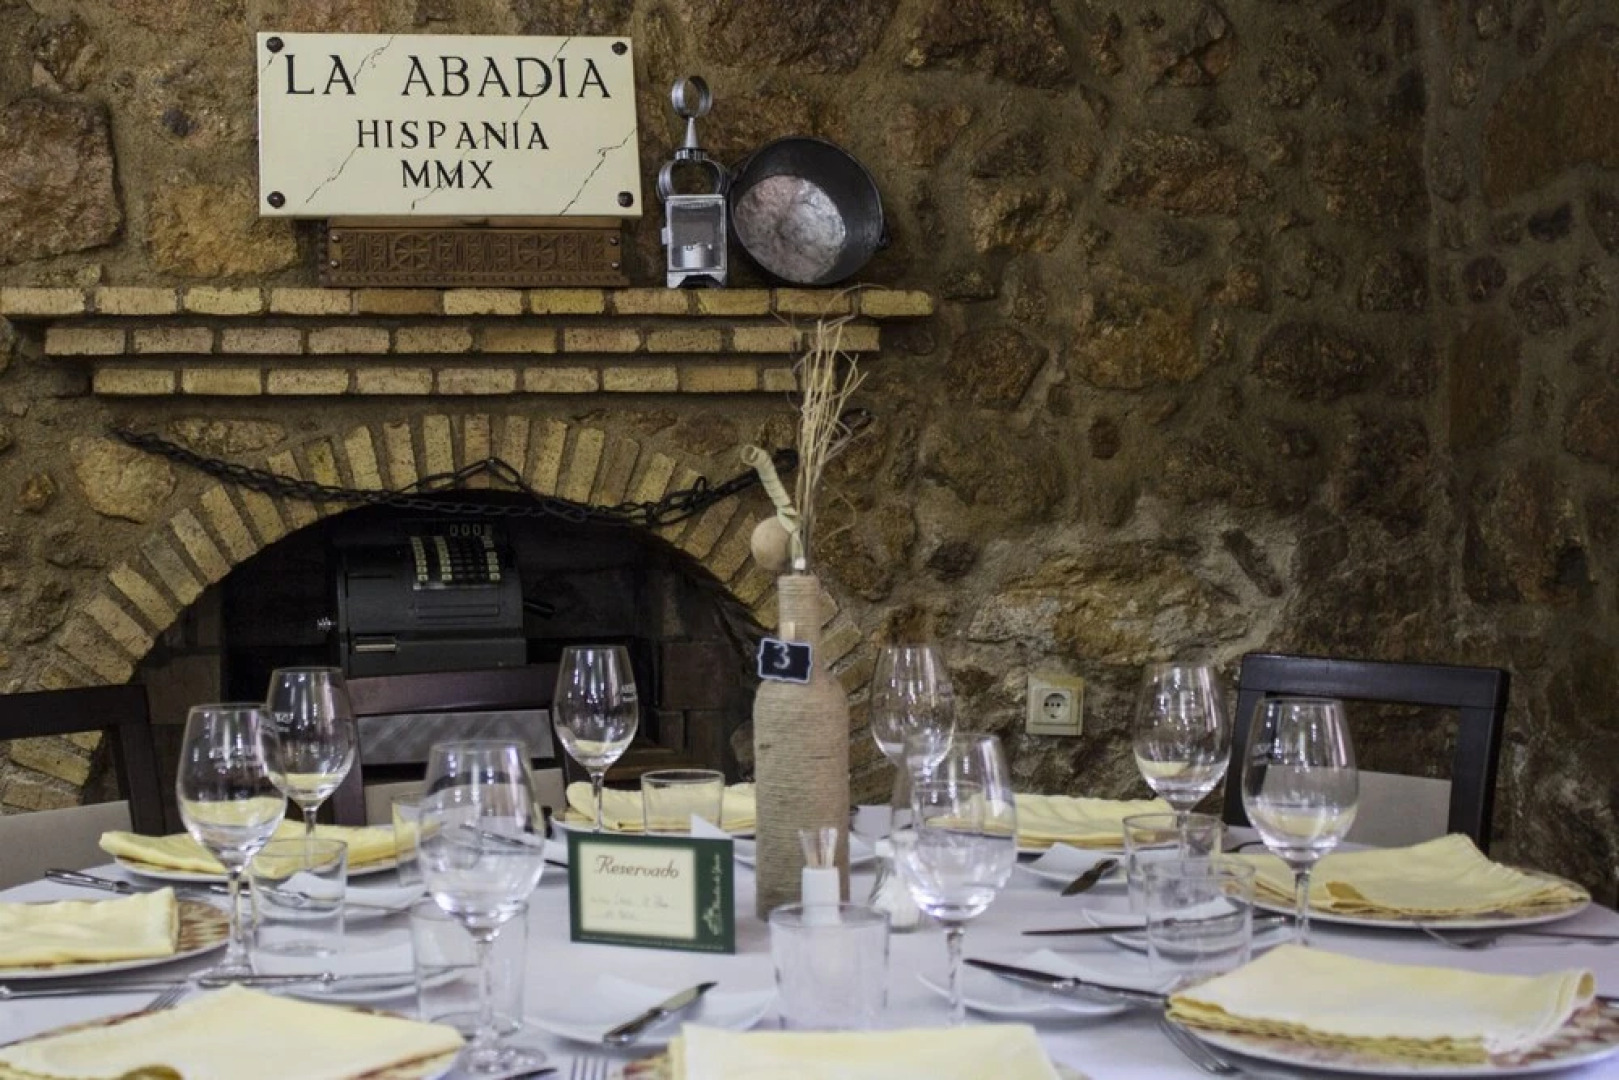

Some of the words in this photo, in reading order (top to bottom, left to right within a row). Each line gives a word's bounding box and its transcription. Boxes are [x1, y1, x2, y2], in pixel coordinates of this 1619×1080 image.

[285, 55, 355, 95] LA
[402, 56, 611, 98] ABADIA
[357, 119, 549, 150] HISPANIA
[401, 159, 493, 188] MMX
[773, 643, 790, 669] 3
[595, 855, 680, 879] Reservado
